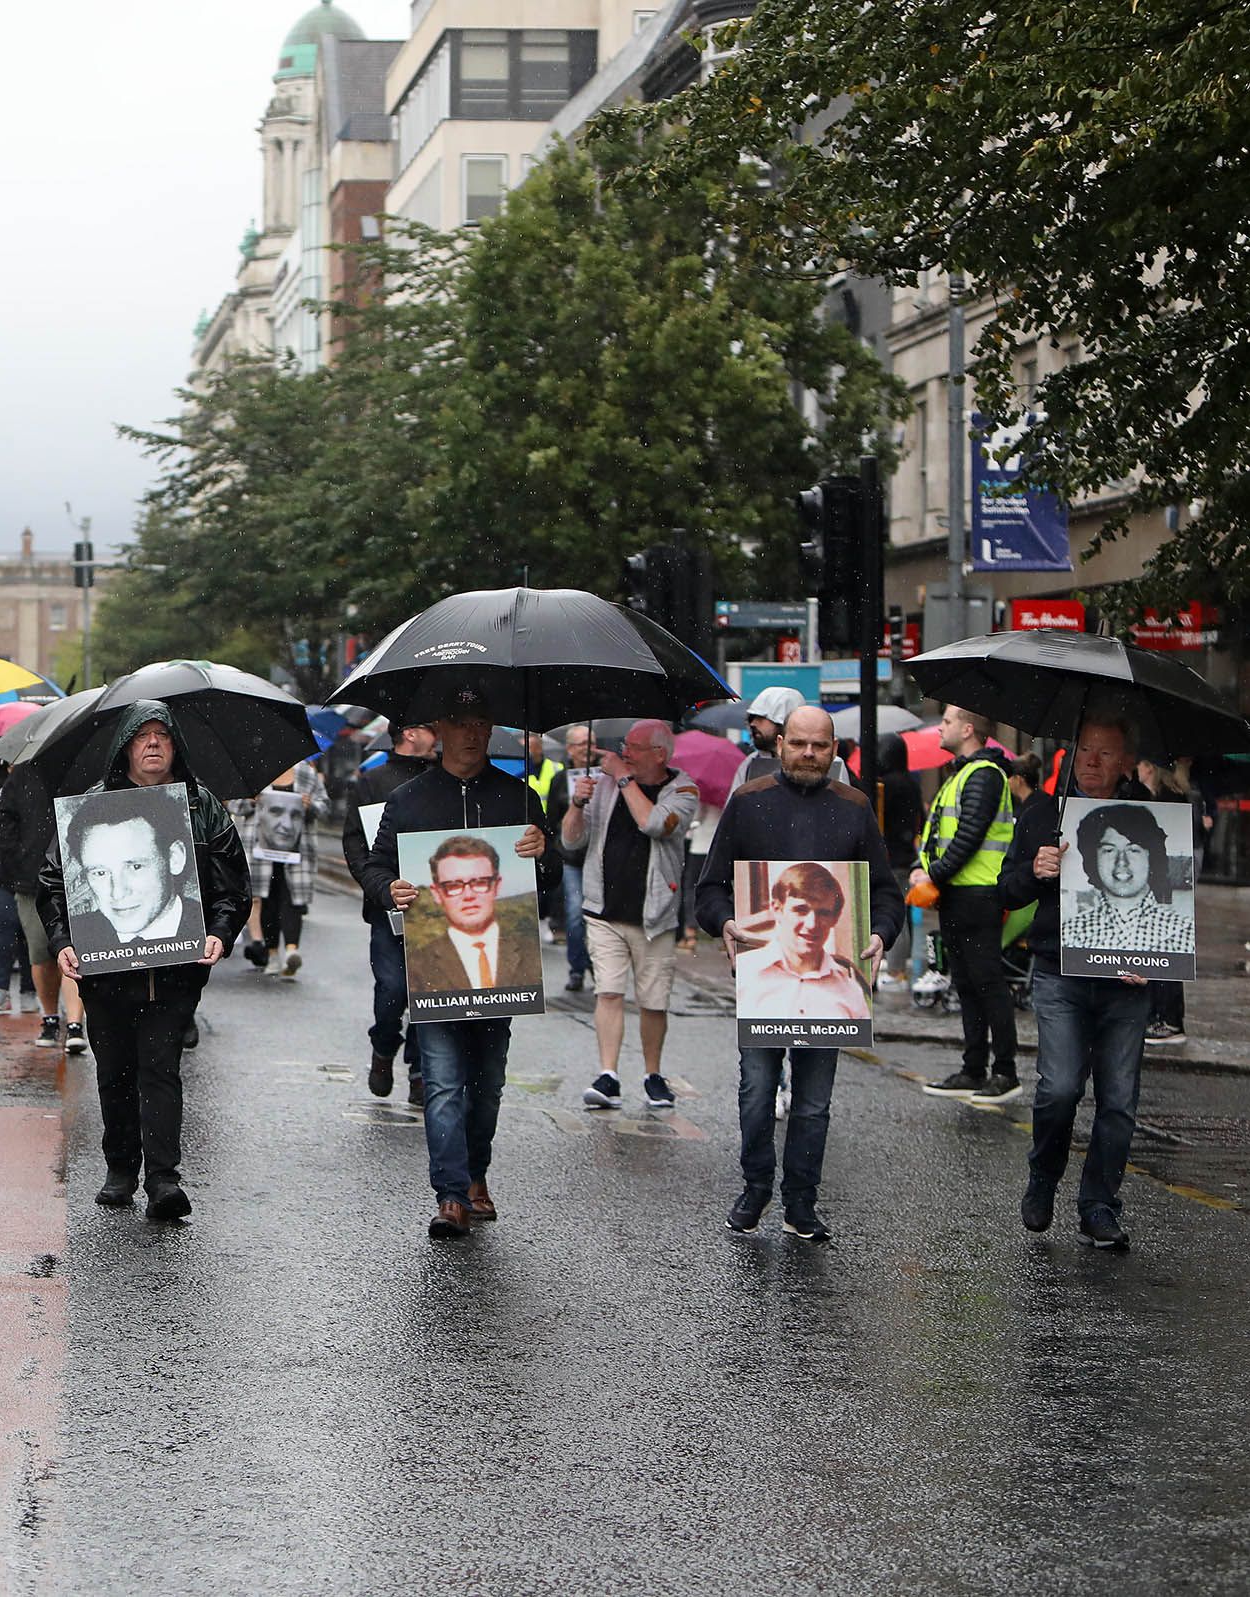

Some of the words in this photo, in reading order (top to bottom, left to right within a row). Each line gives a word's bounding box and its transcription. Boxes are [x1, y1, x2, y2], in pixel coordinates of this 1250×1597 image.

[437, 641, 465, 649] DERRY
[81, 948, 134, 962] GERARD
[137, 940, 200, 956] McKINNEY
[1086, 954, 1121, 965] JOHN
[1123, 956, 1169, 967] YOUNG
[415, 996, 469, 1009] WILLIAM
[472, 991, 537, 1005] McKINNEY
[750, 1024, 808, 1035] MICHAEL
[810, 1025, 859, 1035] McDAID
